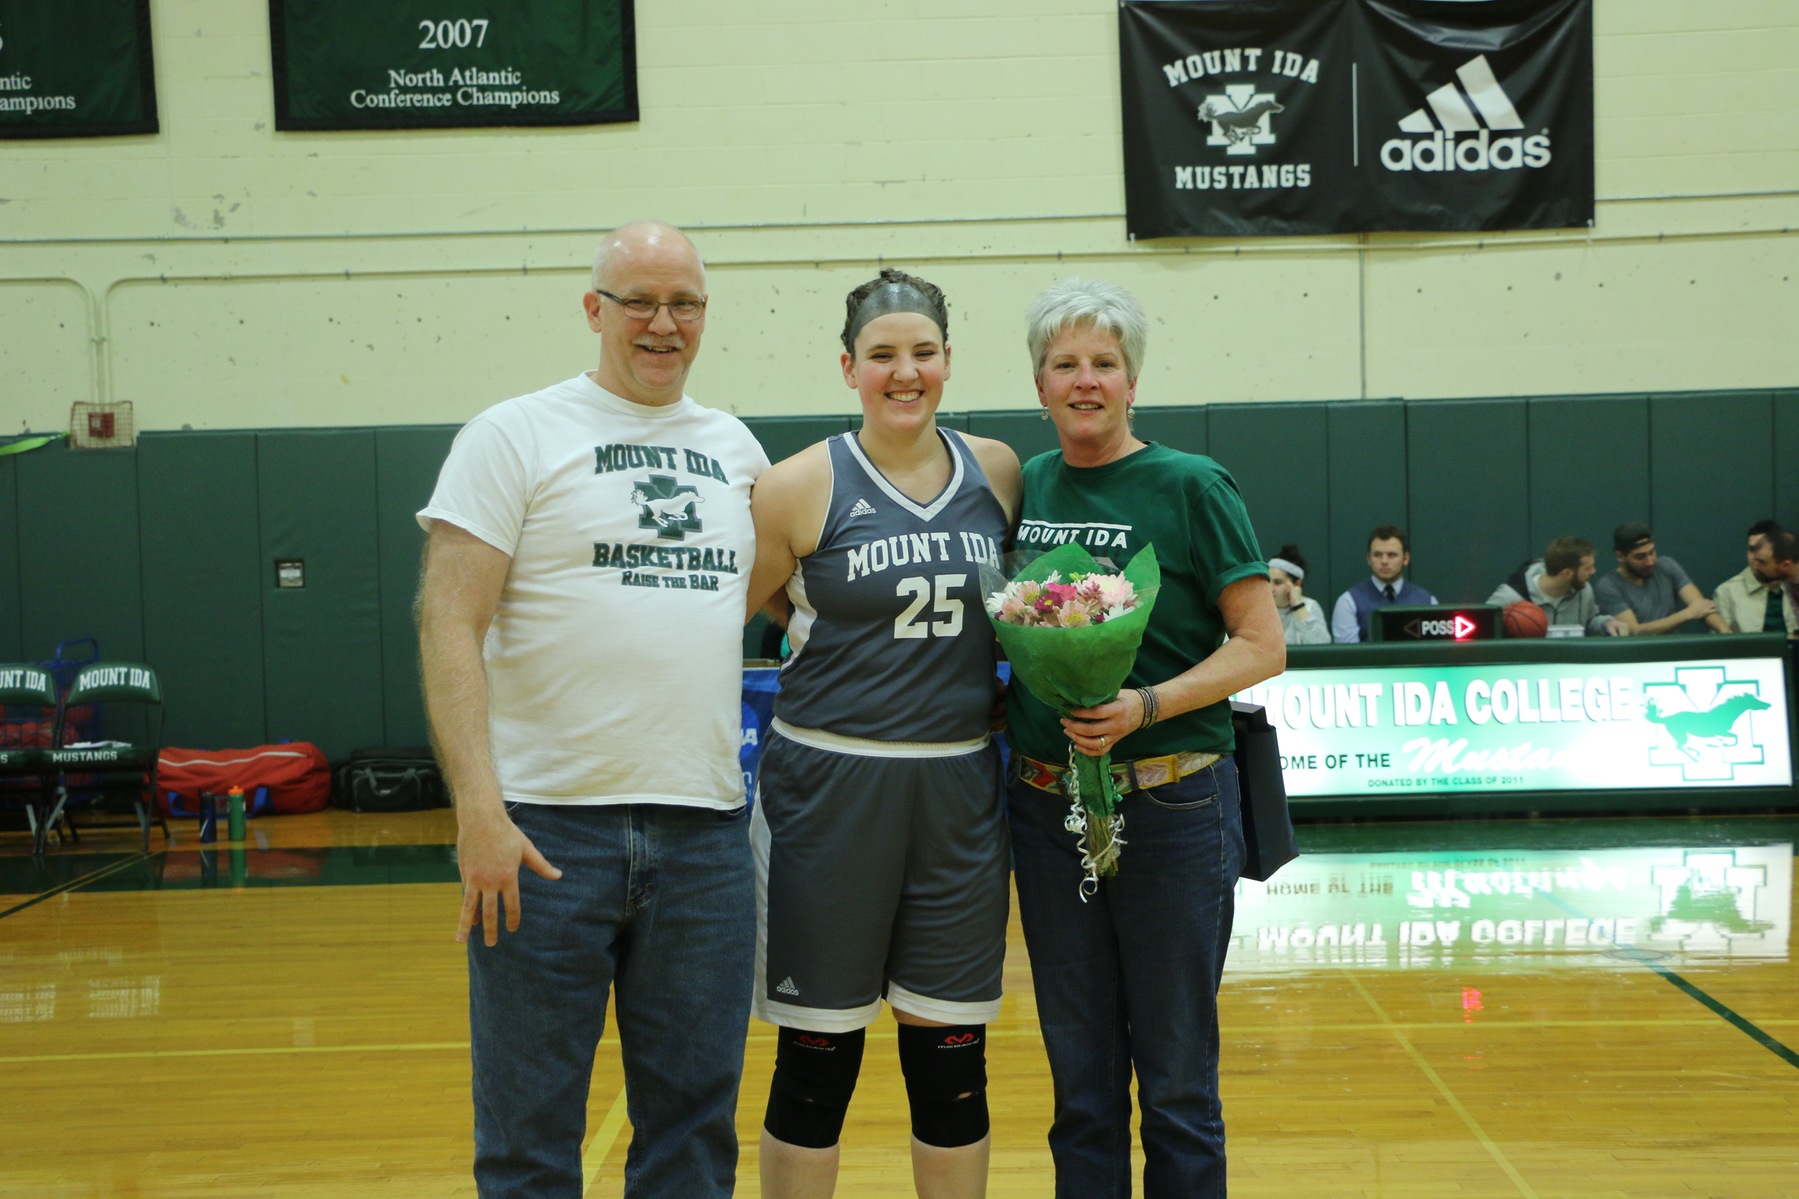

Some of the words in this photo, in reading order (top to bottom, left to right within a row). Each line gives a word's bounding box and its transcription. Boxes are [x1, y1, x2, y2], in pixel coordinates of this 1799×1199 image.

[418, 18, 489, 49] 2007
[387, 68, 444, 88] North
[448, 66, 522, 86] Atlantic
[1162, 47, 1263, 88] MOUNT
[1271, 49, 1320, 85] IDA
[350, 88, 452, 109] Conference
[456, 86, 560, 109] Champions
[1380, 129, 1552, 172] adidas
[1174, 164, 1311, 190] MUSTANGS
[594, 443, 678, 475] MOUNT
[683, 448, 730, 486] IDA
[849, 506, 877, 518] adidas
[1016, 524, 1081, 545] MOUNT
[1085, 529, 1128, 549] IDA
[592, 542, 739, 575] BASKETBALL
[847, 531, 951, 582] MOUNT
[959, 531, 1001, 570] IDA
[621, 570, 660, 588] RAISE
[662, 575, 687, 589] THE
[688, 573, 720, 592] BAR
[893, 573, 968, 639] 25
[1421, 619, 1455, 636] POSS
[25, 670, 47, 692] IDA
[79, 666, 128, 692] MOUNT
[129, 667, 151, 689] IDA
[1252, 682, 1383, 730] MOUNT
[1392, 681, 1458, 727] IDA
[1464, 677, 1633, 725] COLLEGE
[52, 751, 118, 763] MUSTANGS
[1280, 755, 1317, 771] OME
[1325, 754, 1348, 769] OF
[1355, 753, 1391, 768] THE
[1368, 778, 1413, 788] DONATED
[1416, 778, 1428, 787] BY
[1432, 777, 1449, 786] THE
[1453, 776, 1483, 786] CLASS
[1485, 776, 1498, 785] OF
[1501, 775, 1524, 785] 2011
